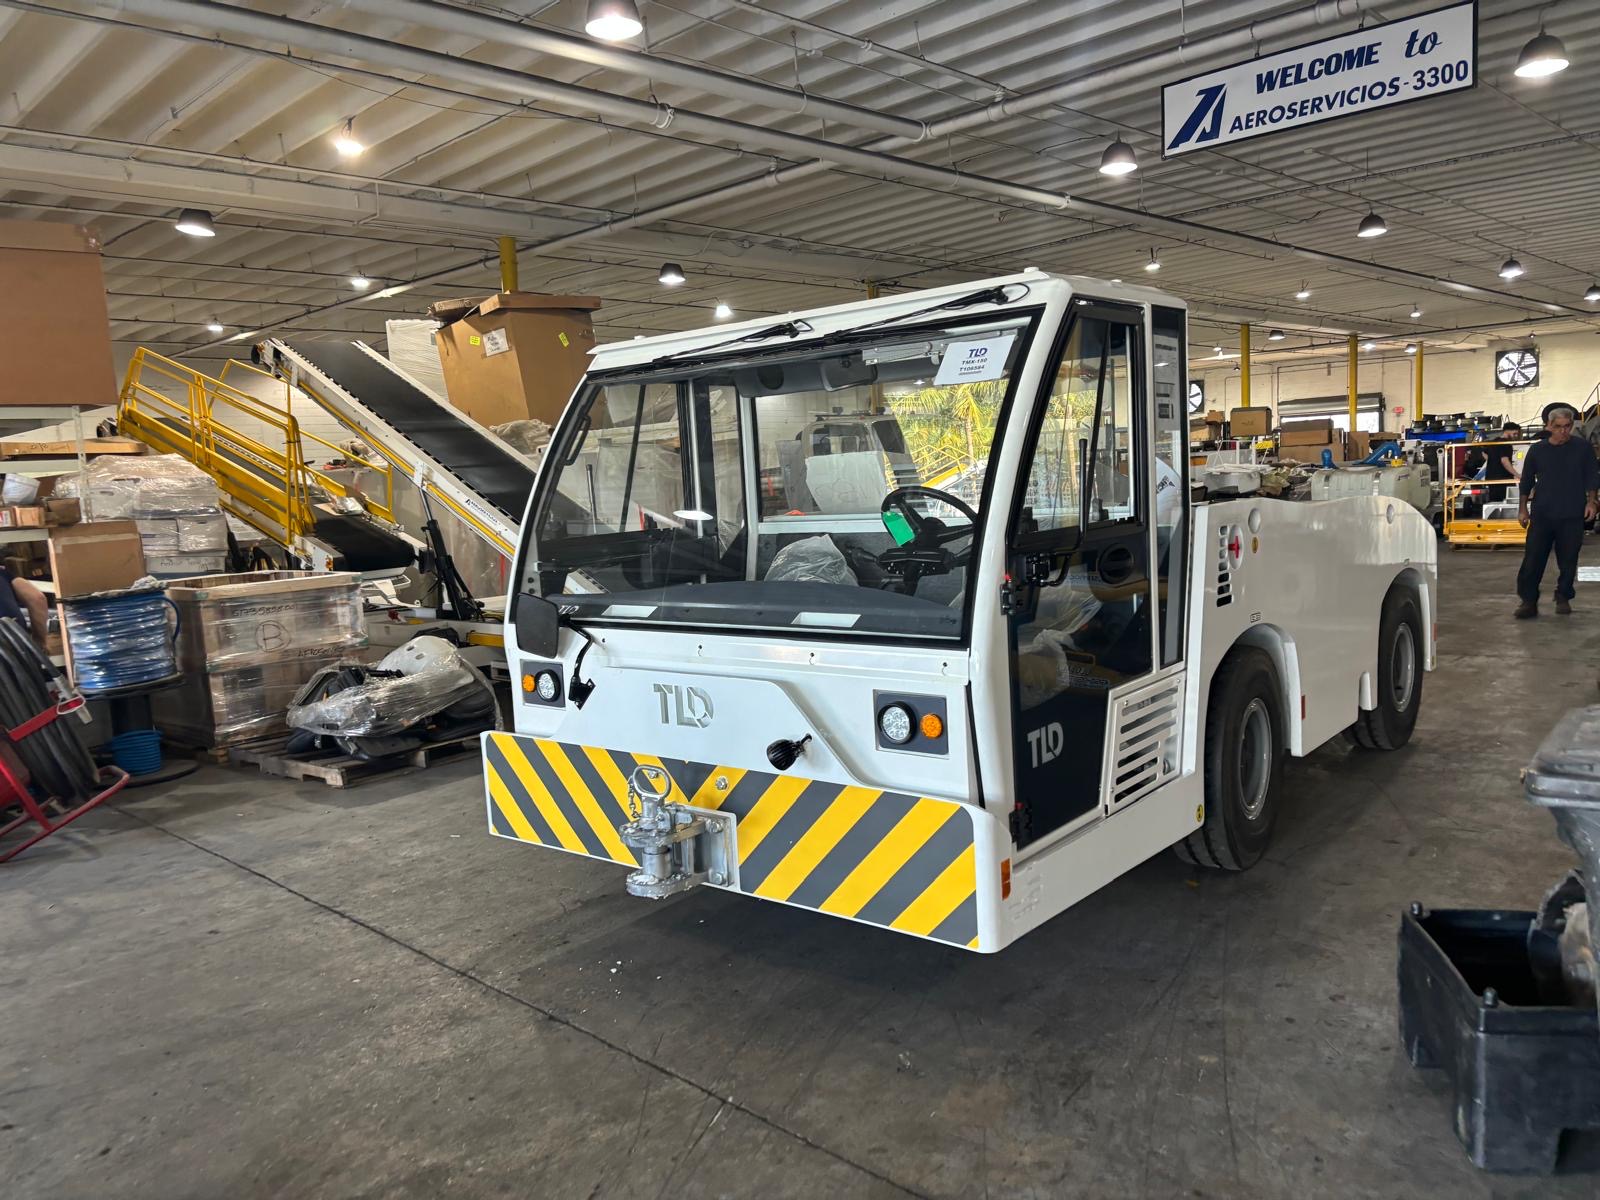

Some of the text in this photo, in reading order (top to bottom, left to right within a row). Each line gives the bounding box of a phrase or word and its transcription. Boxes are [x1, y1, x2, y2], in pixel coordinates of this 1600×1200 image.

[1256, 29, 1443, 95] WELCOME to
[969, 347, 988, 358] TLD
[653, 683, 714, 729] TLD
[1027, 721, 1064, 769] TLD
